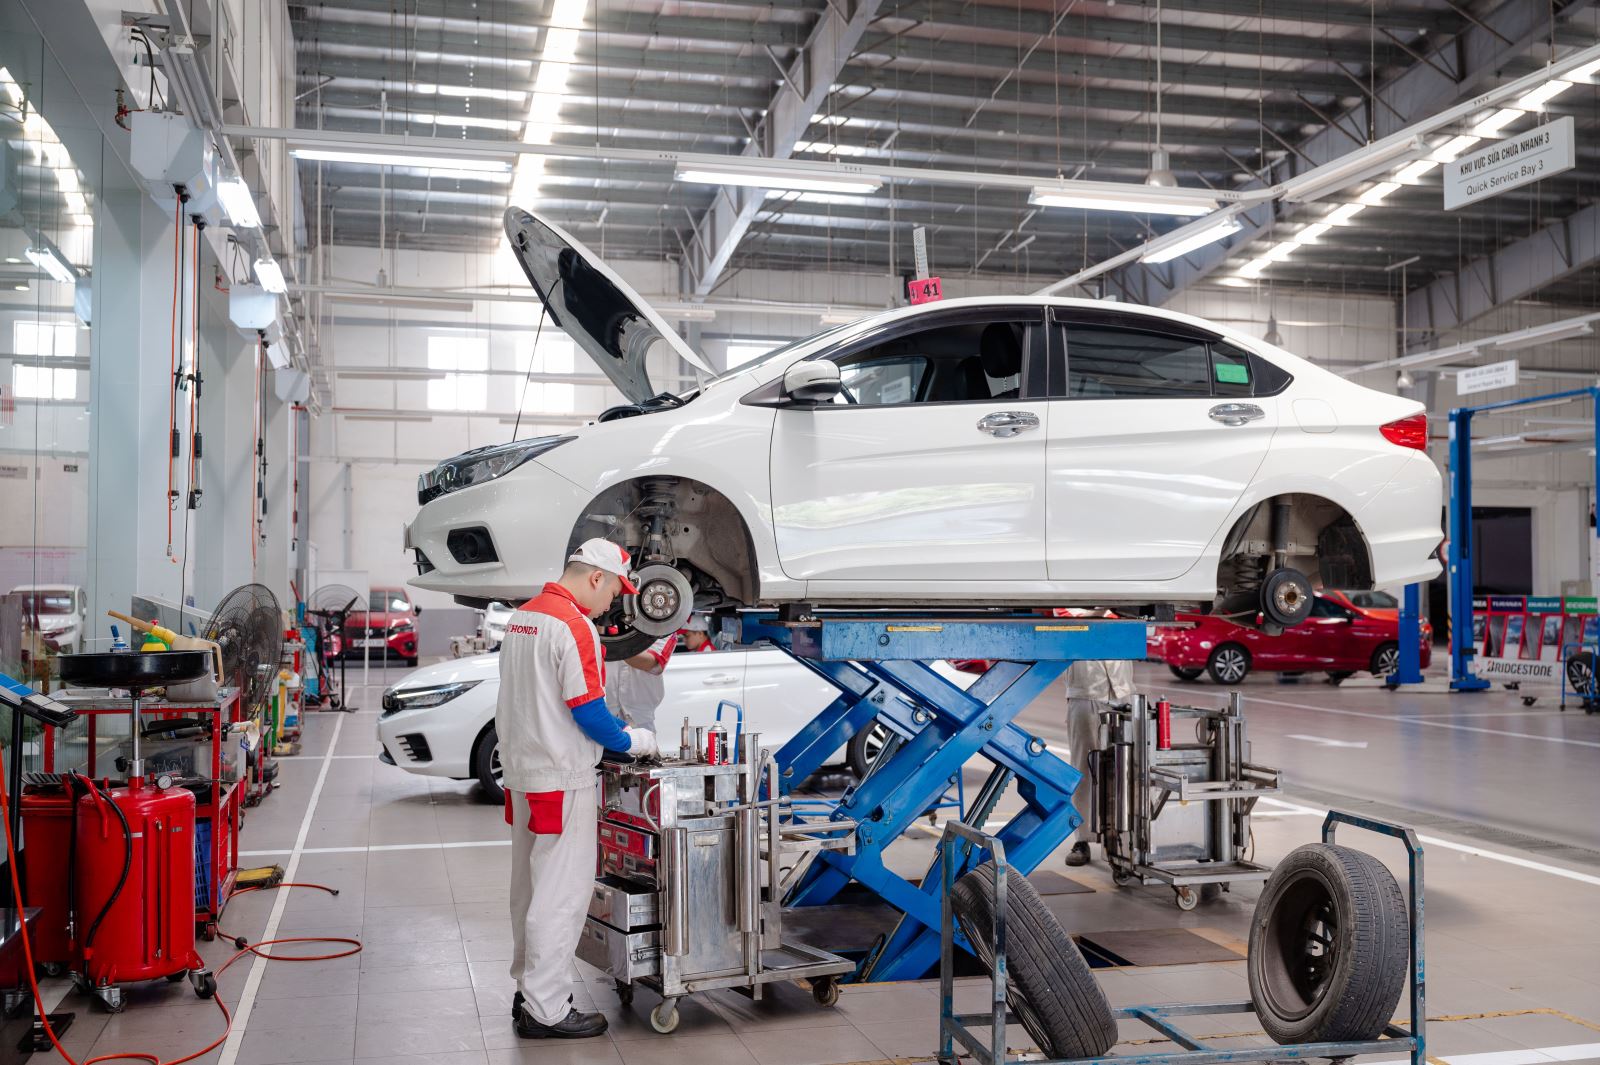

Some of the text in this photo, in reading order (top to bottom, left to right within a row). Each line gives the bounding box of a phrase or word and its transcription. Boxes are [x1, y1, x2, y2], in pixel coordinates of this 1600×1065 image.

[1460, 160, 1472, 176] KHU
[1520, 134, 1544, 152] NHANH
[1544, 132, 1549, 143] 3
[1466, 160, 1544, 196] Quick Service Bay 3
[923, 282, 939, 297] 41
[510, 624, 538, 635] HONDA
[1487, 660, 1552, 677] BRIDGESTONE
